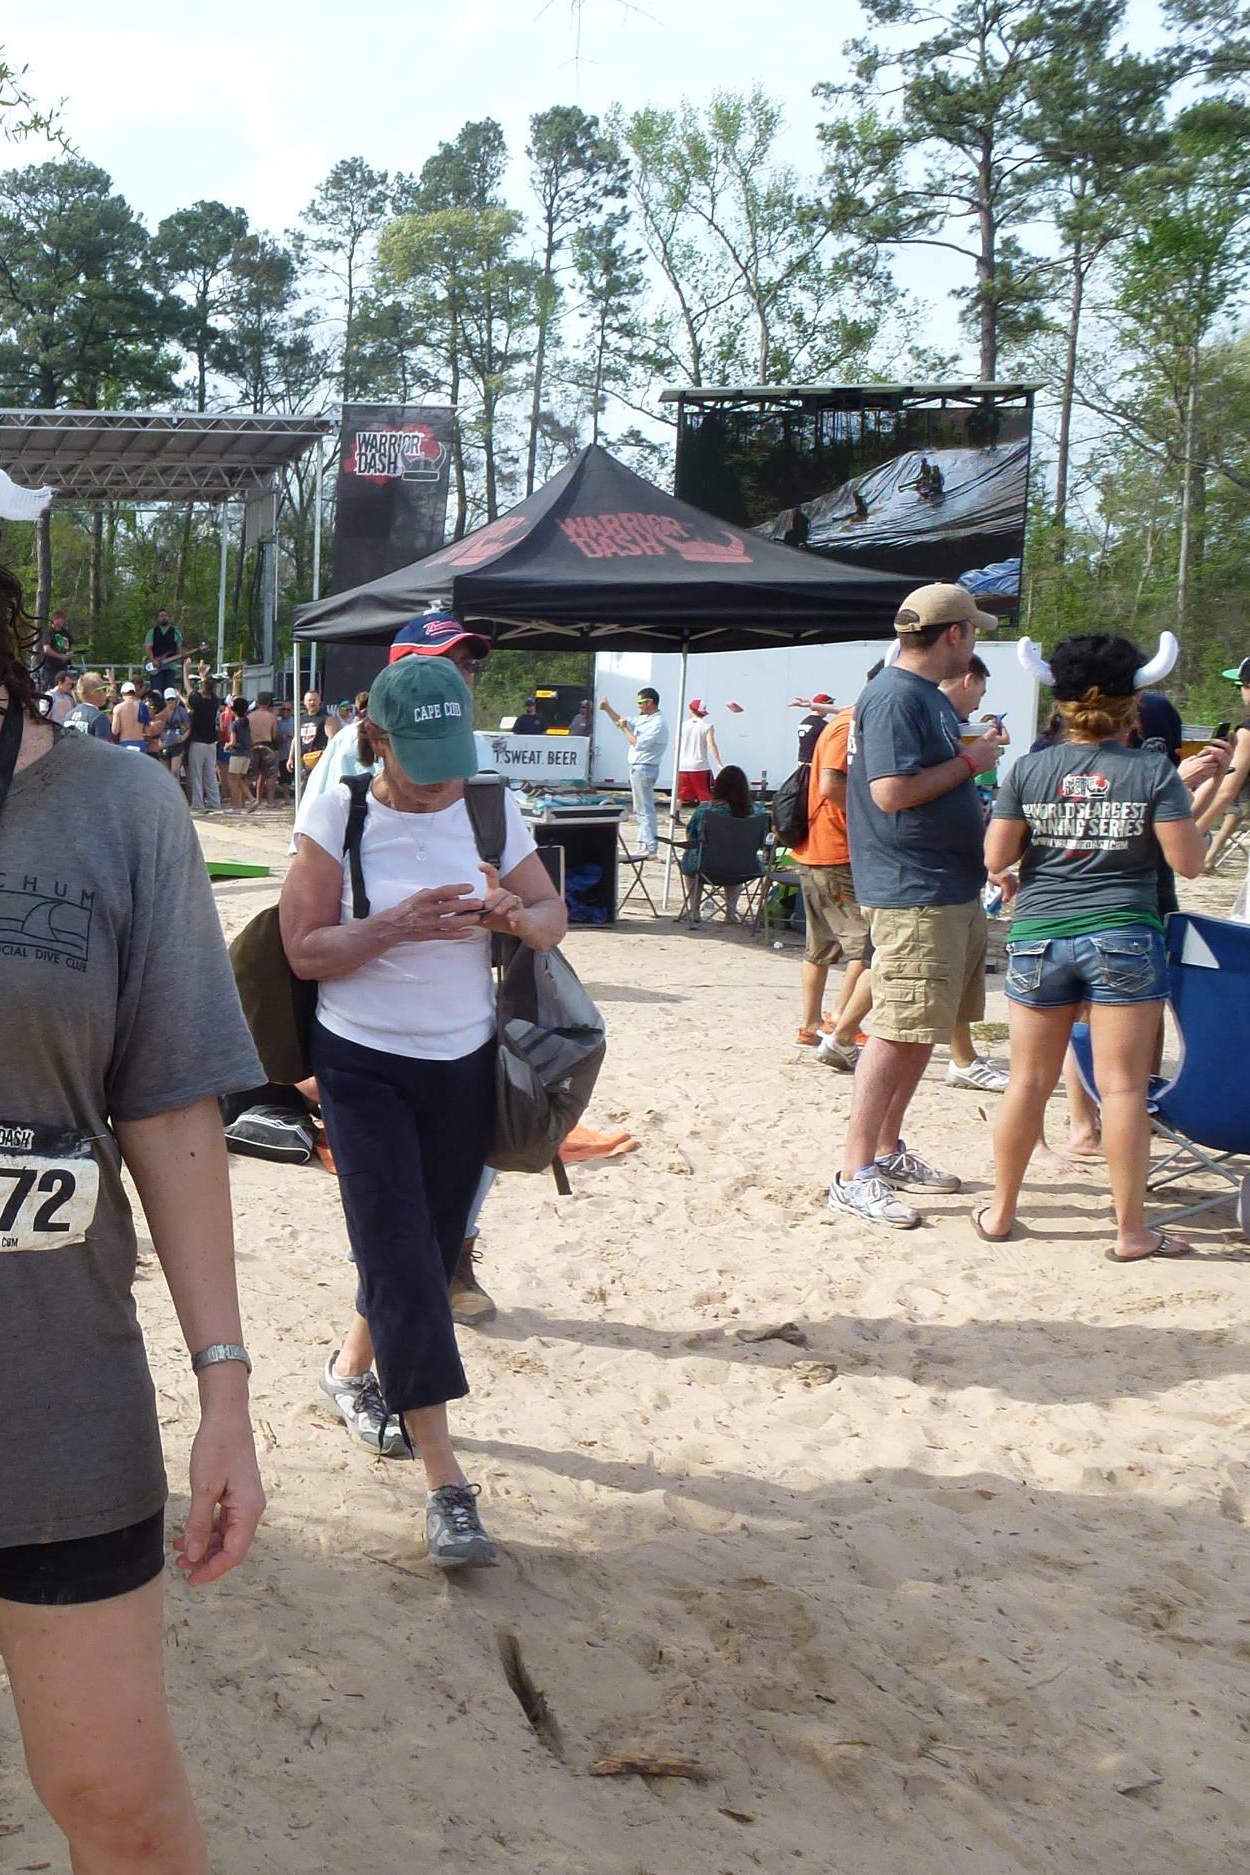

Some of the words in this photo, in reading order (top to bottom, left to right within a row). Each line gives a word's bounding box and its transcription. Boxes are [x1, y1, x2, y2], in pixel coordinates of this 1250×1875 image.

[357, 433, 420, 455] WARRIOR
[357, 453, 397, 474] DASH
[558, 512, 689, 537] WARRIOR
[571, 533, 668, 558] DASH
[414, 704, 442, 722] CAPE
[444, 702, 462, 716] COD
[547, 751, 577, 765] BEER
[1084, 801, 1148, 820] LARGEST
[1088, 819, 1144, 838] SERIES
[35, 948, 60, 963] DIVE
